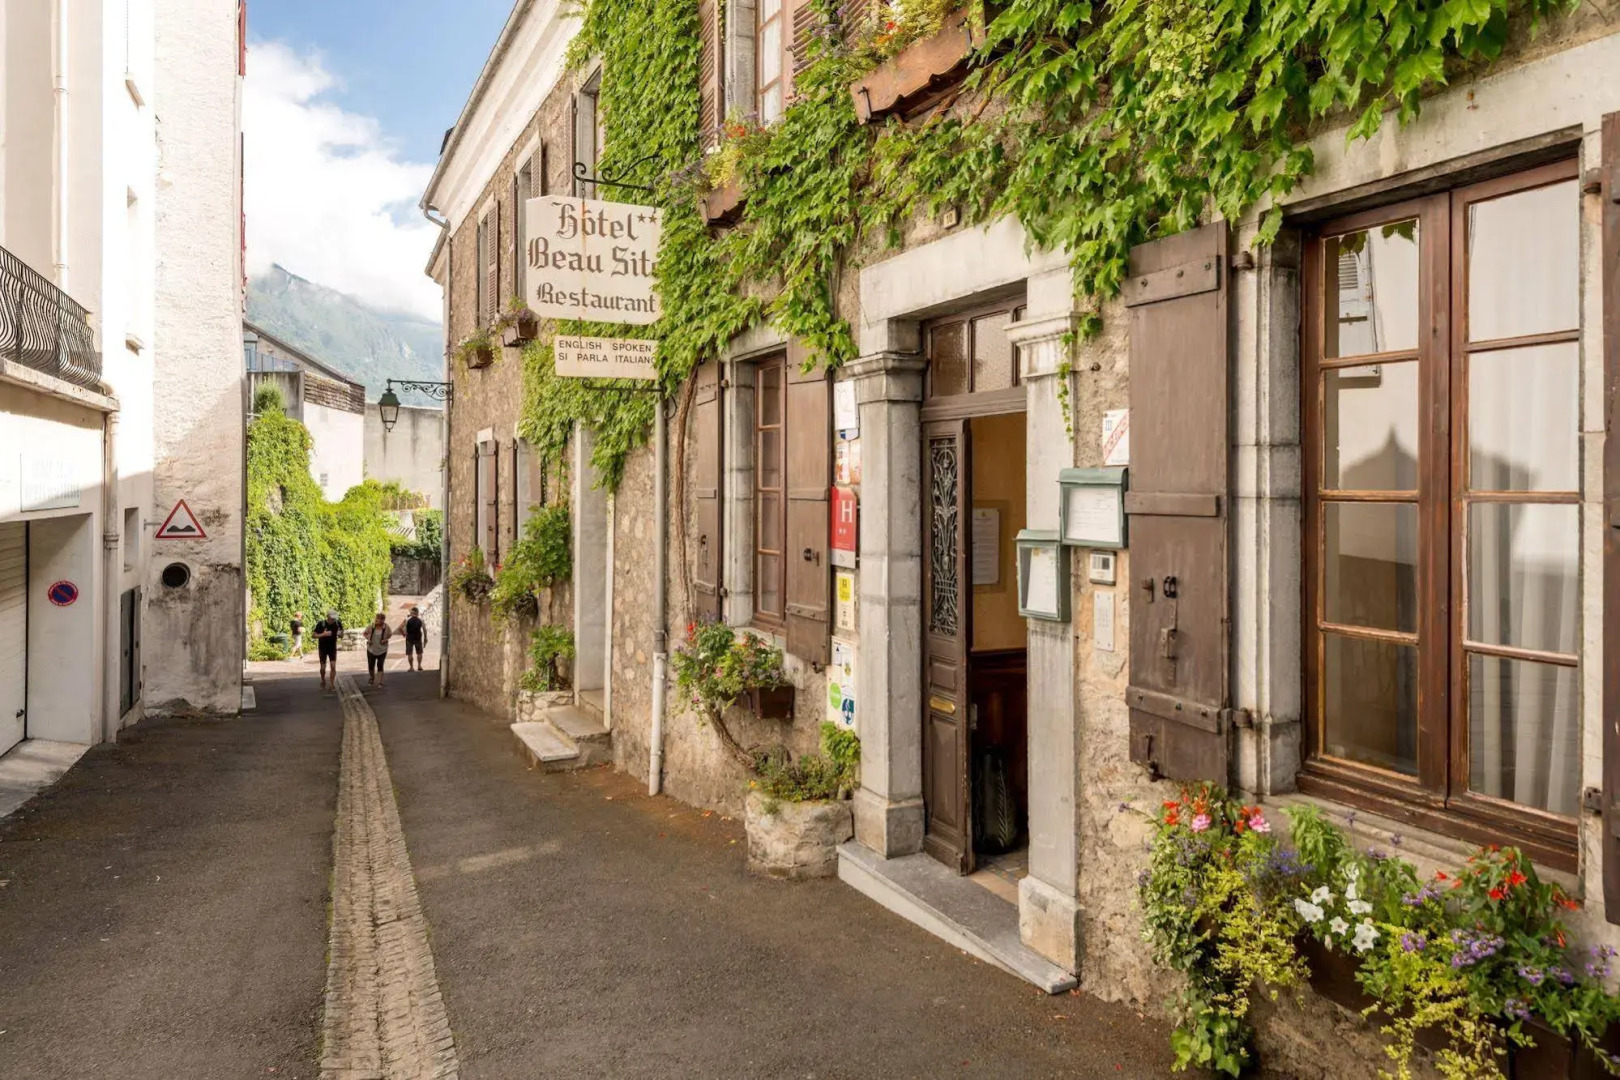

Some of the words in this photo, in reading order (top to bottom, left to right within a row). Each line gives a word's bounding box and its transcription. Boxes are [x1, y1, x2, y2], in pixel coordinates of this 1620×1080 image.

[528, 237, 603, 273] Beau
[537, 282, 656, 313] Restaurant
[559, 340, 602, 350] ENGLISH
[612, 343, 652, 352] SPOKEN
[559, 352, 568, 361] SI
[577, 353, 608, 362] PARLA
[841, 500, 853, 523] H
